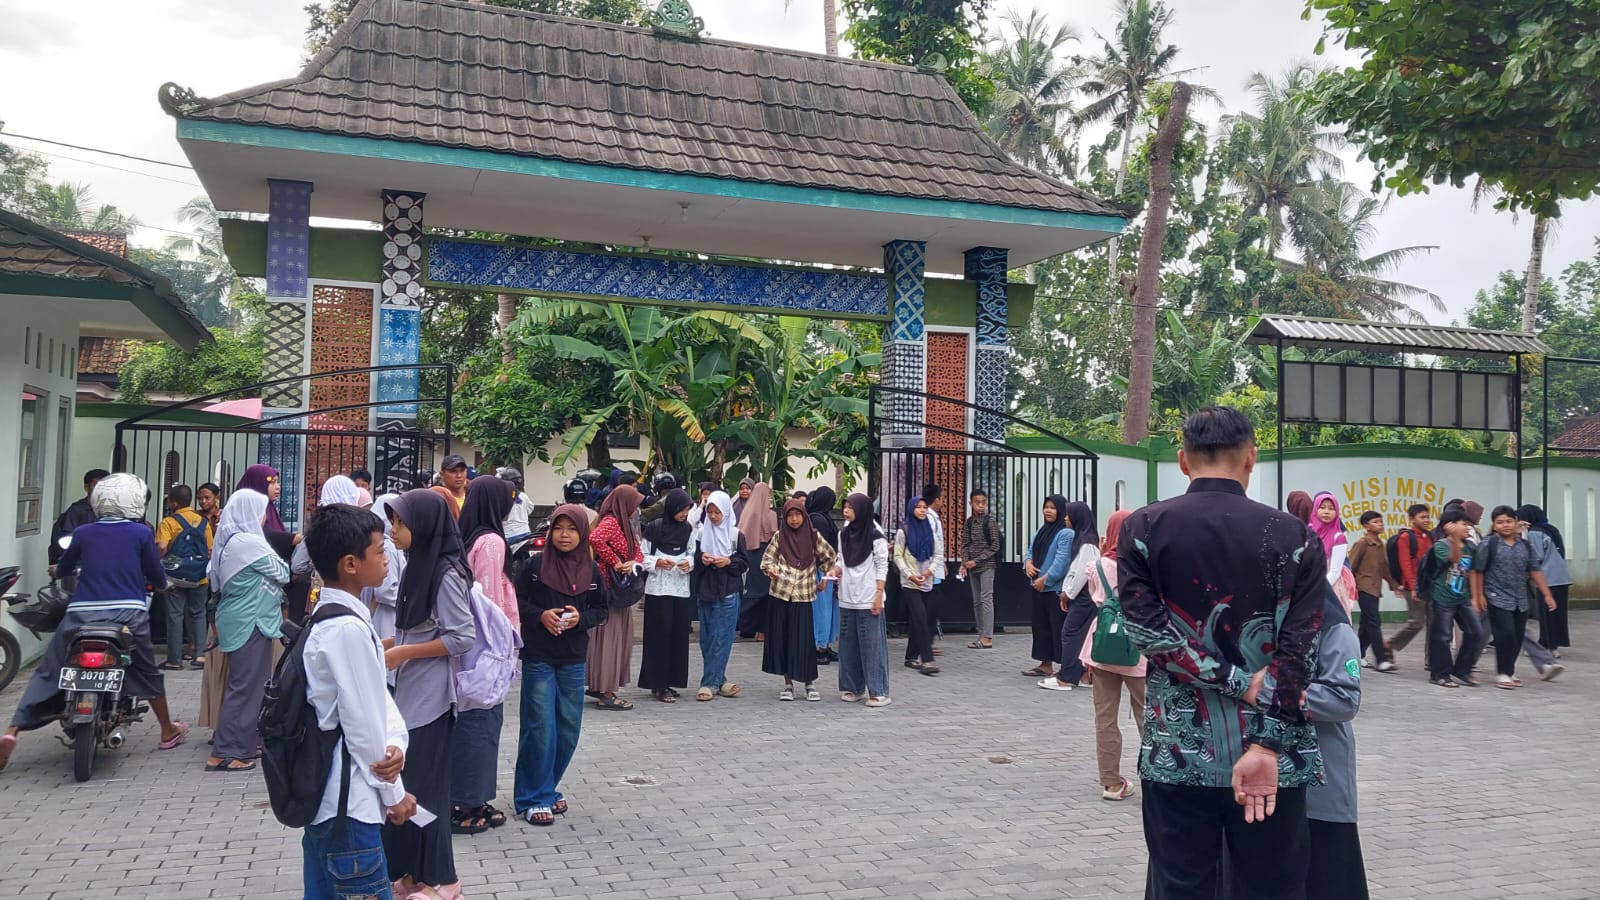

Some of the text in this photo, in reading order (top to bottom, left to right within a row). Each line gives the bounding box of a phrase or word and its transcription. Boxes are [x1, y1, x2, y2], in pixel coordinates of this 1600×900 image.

[1342, 477, 1445, 505] VISI MISI
[1379, 499, 1388, 512] 6
[81, 671, 104, 680] 3070
